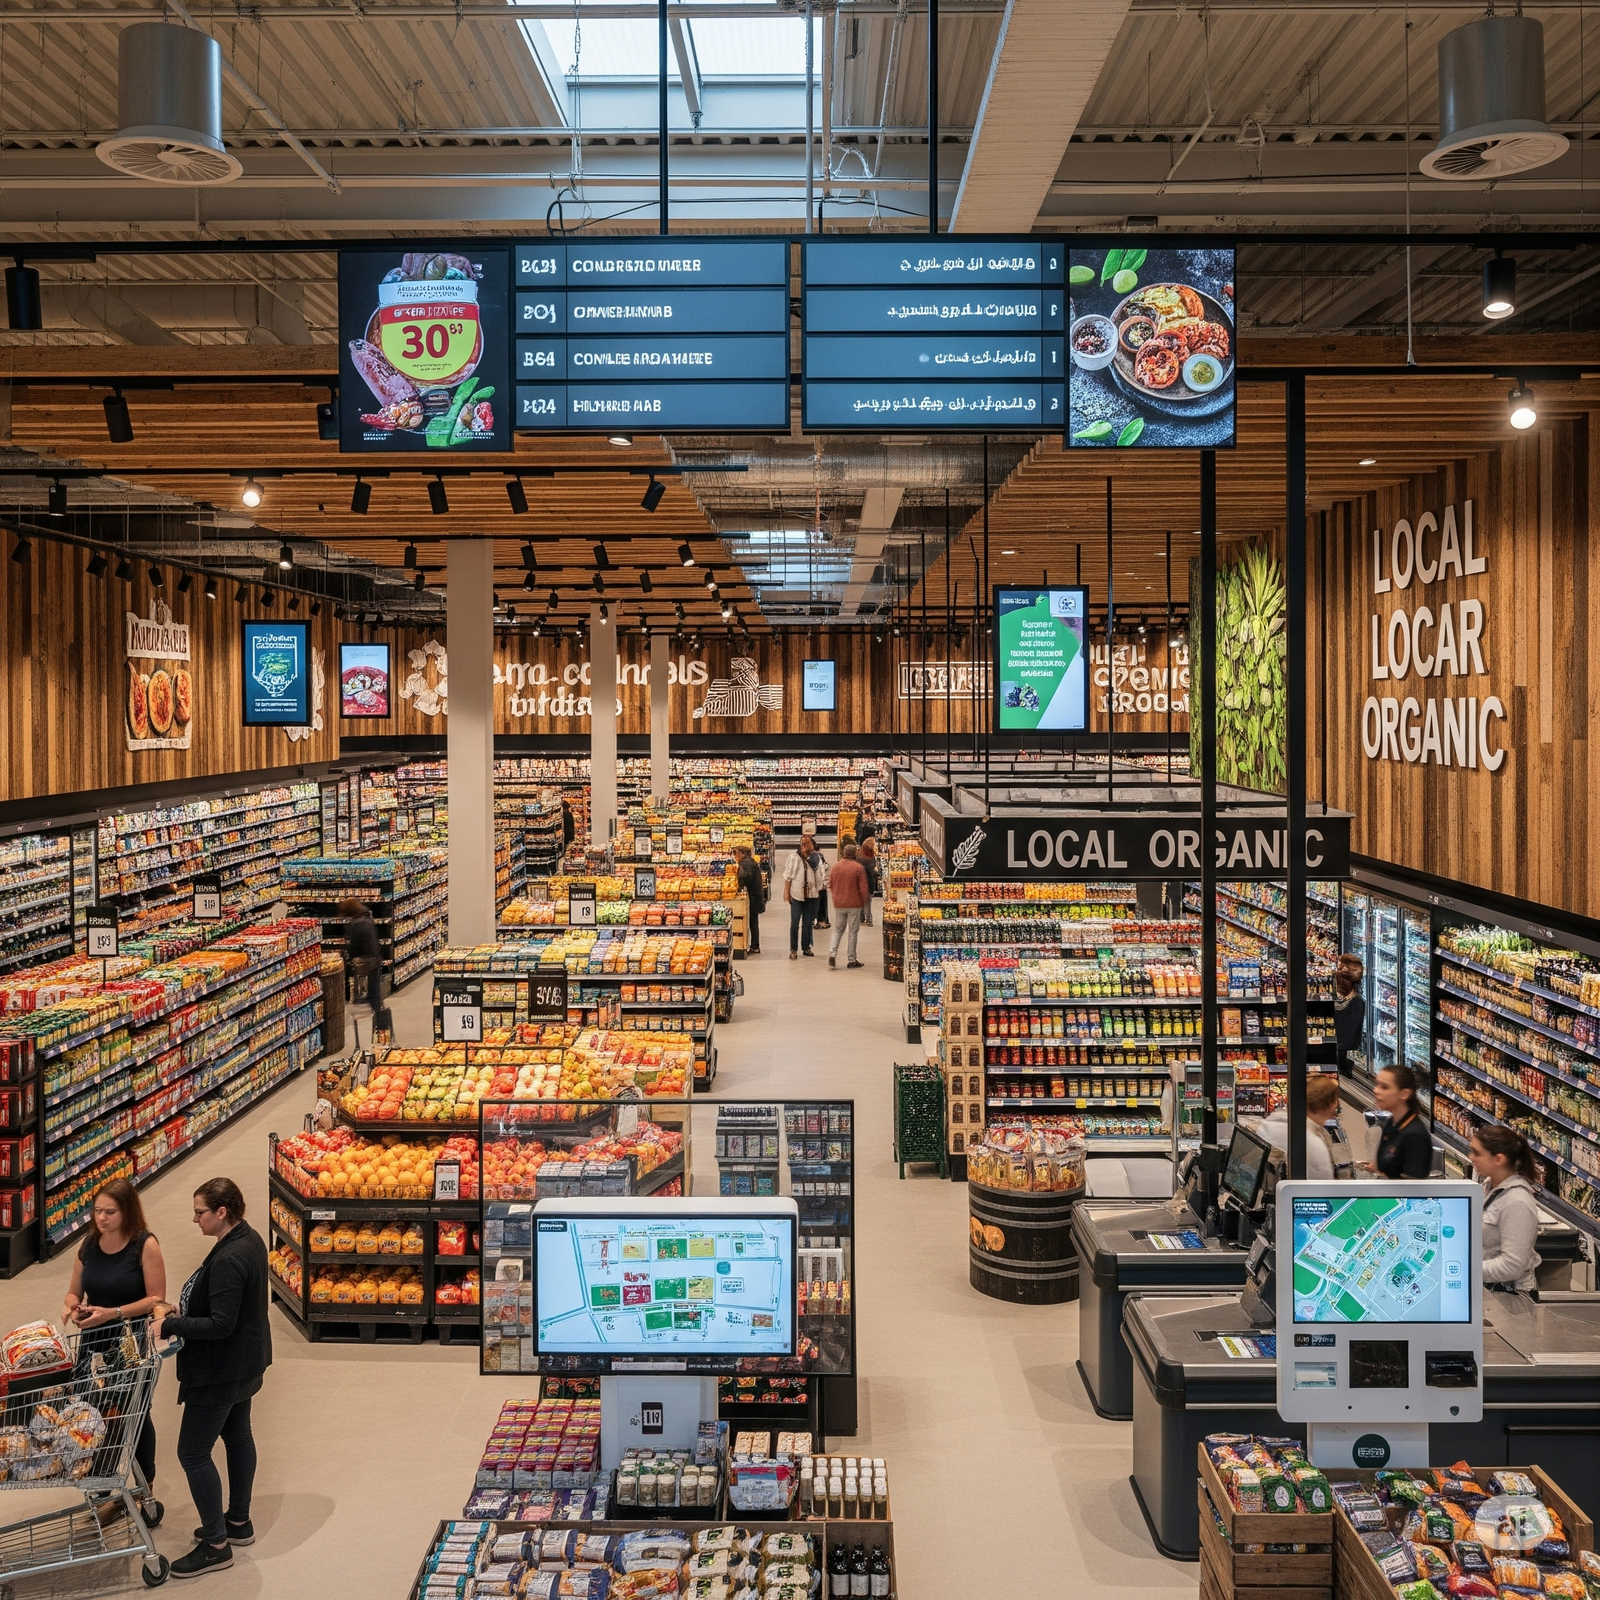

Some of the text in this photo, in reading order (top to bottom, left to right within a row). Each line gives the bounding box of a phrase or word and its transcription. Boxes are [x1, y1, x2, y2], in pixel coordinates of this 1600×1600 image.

[401, 324, 450, 360] 30
[1373, 500, 1485, 594] LOCAL
[1372, 599, 1485, 680] LOCAR
[1362, 696, 1504, 772] ORGANIC
[1007, 829, 1127, 868] LOCAL
